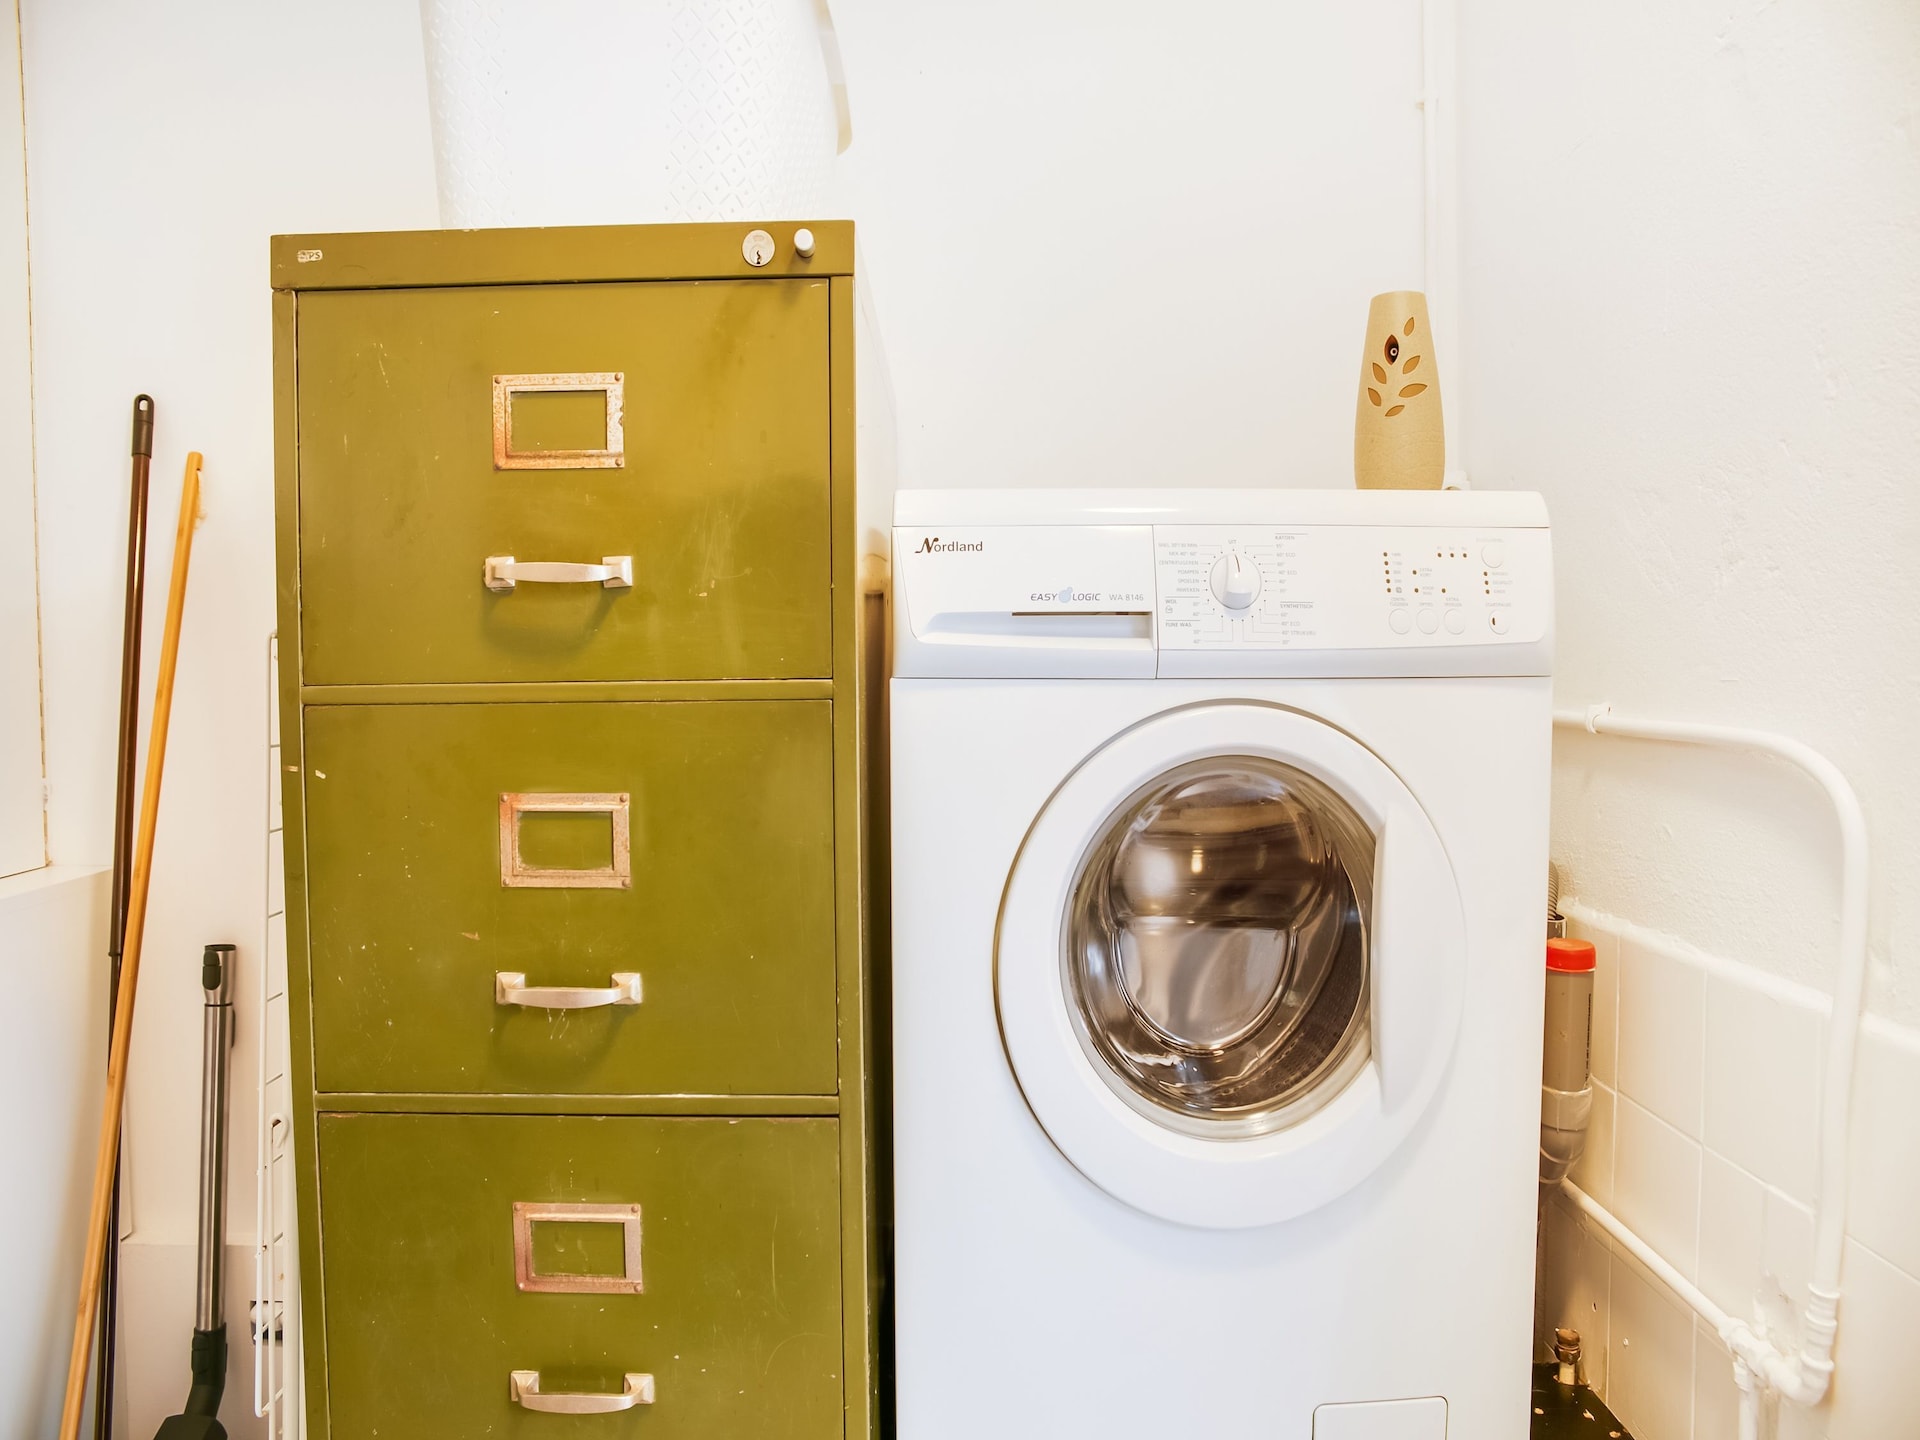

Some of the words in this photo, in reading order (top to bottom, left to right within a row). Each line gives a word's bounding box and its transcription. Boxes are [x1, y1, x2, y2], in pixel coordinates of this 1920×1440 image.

[914, 537, 983, 554] Nordland
[1030, 592, 1058, 602] EASY
[1072, 592, 1101, 602] LOGIC
[1109, 593, 1124, 602] WA
[1125, 593, 1144, 602] 8146
